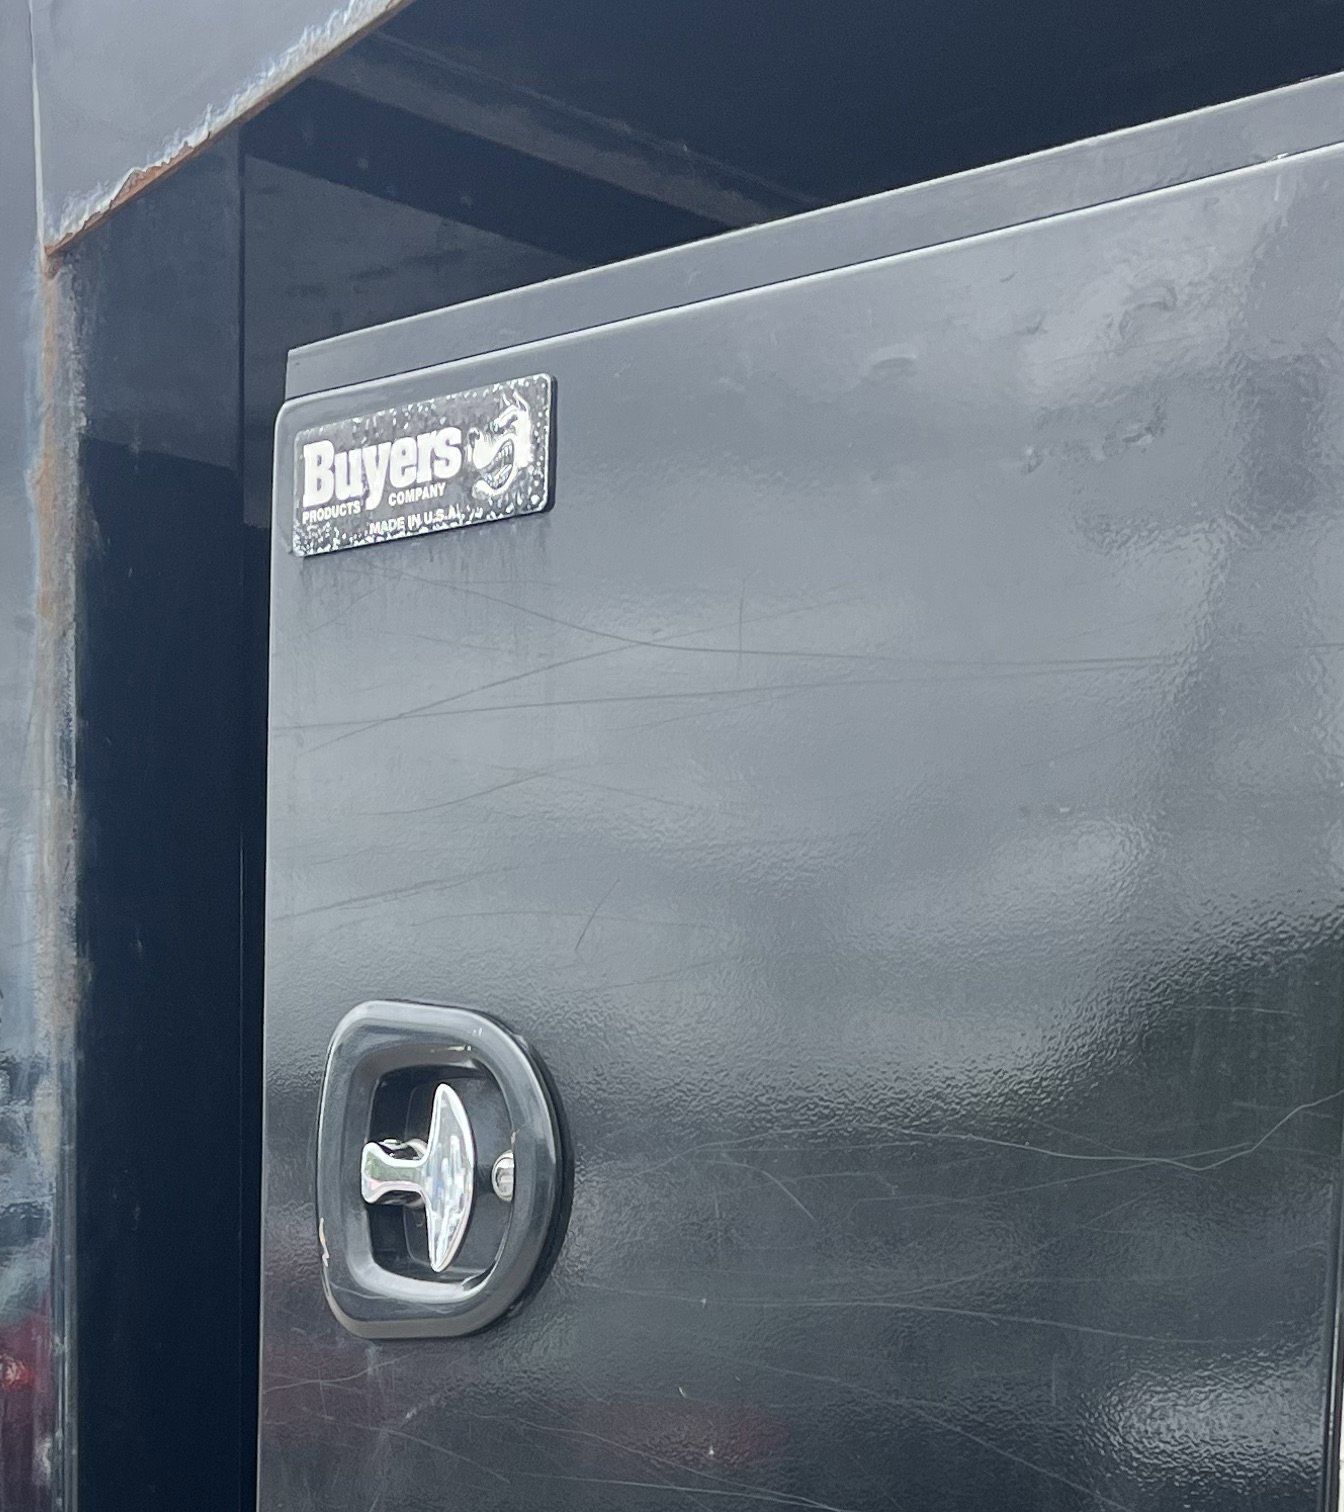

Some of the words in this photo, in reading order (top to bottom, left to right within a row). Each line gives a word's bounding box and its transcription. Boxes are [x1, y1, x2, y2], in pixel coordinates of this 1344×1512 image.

[302, 427, 462, 510] Buyers
[302, 500, 362, 525] PRODUCTS
[388, 482, 446, 507] COMPANY
[369, 516, 405, 535] MADE
[407, 513, 422, 531] IN
